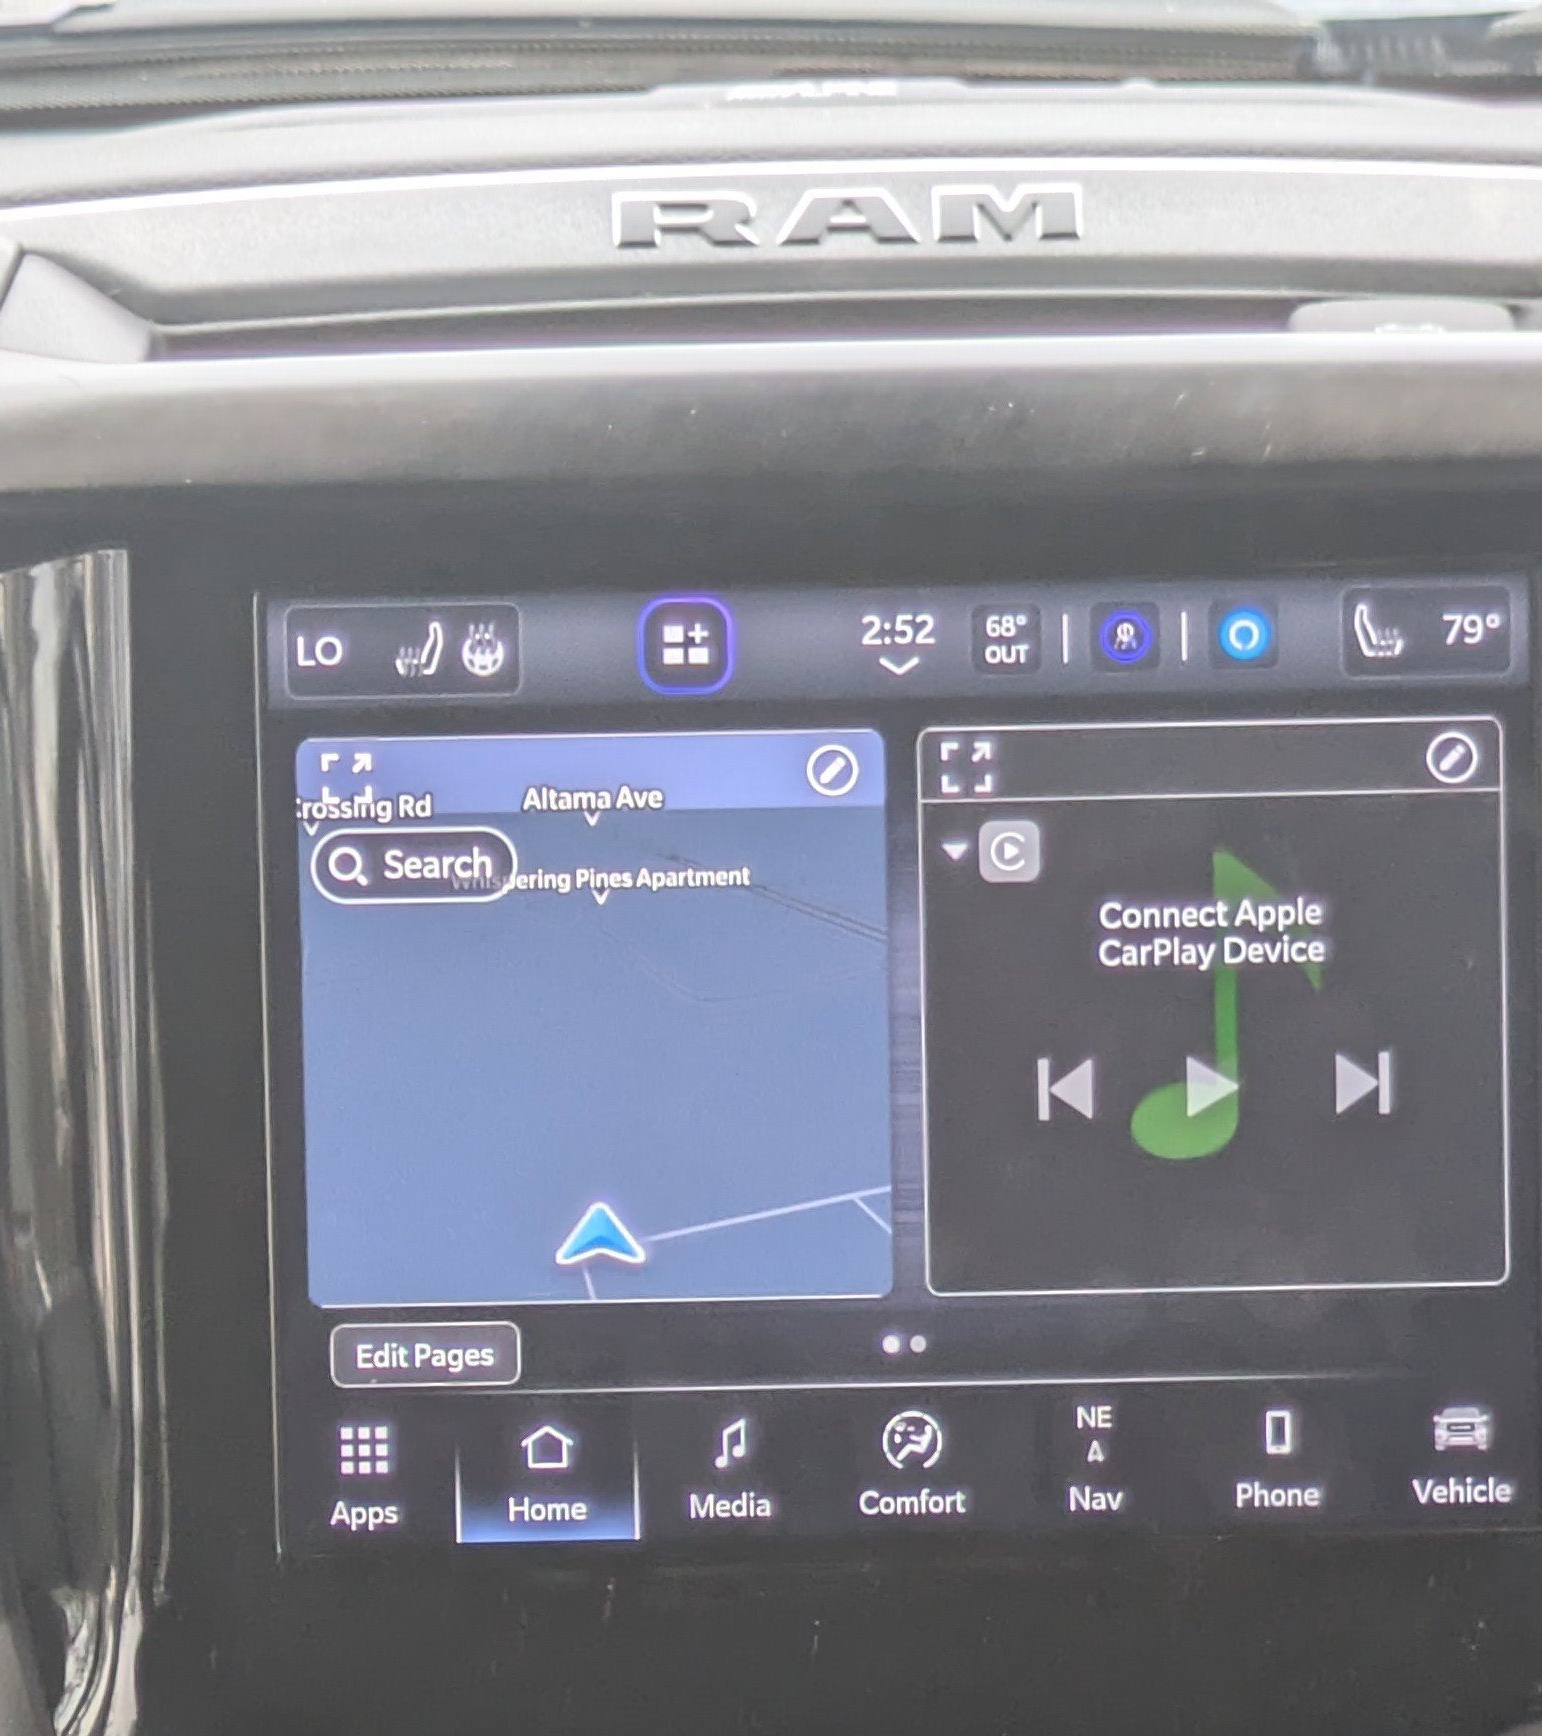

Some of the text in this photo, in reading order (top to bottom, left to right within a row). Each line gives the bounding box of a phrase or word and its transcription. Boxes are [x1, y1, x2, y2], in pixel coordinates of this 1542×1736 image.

[611, 183, 1082, 249] RAM
[861, 614, 936, 646] 2:52
[985, 614, 1028, 638] 68°
[297, 636, 343, 668] LO
[984, 645, 1029, 665] OUT
[296, 793, 433, 823] rossing Rd
[522, 785, 664, 812] Altama Ave
[383, 846, 493, 880] Search
[576, 868, 633, 890] Pines
[636, 866, 750, 892] Apartment
[1099, 896, 1323, 932] Connect Apple
[1098, 935, 1327, 972] CarPlay Device
[357, 1342, 495, 1374] Edit Pages
[1076, 1405, 1112, 1429] NE
[859, 1488, 966, 1516] Comfort
[1068, 1486, 1123, 1512] Nav
[1236, 1482, 1321, 1509] Phone
[1412, 1478, 1513, 1505] Vehicle
[331, 1500, 399, 1530] Apps
[508, 1497, 588, 1522] Home
[689, 1493, 772, 1519] Media
